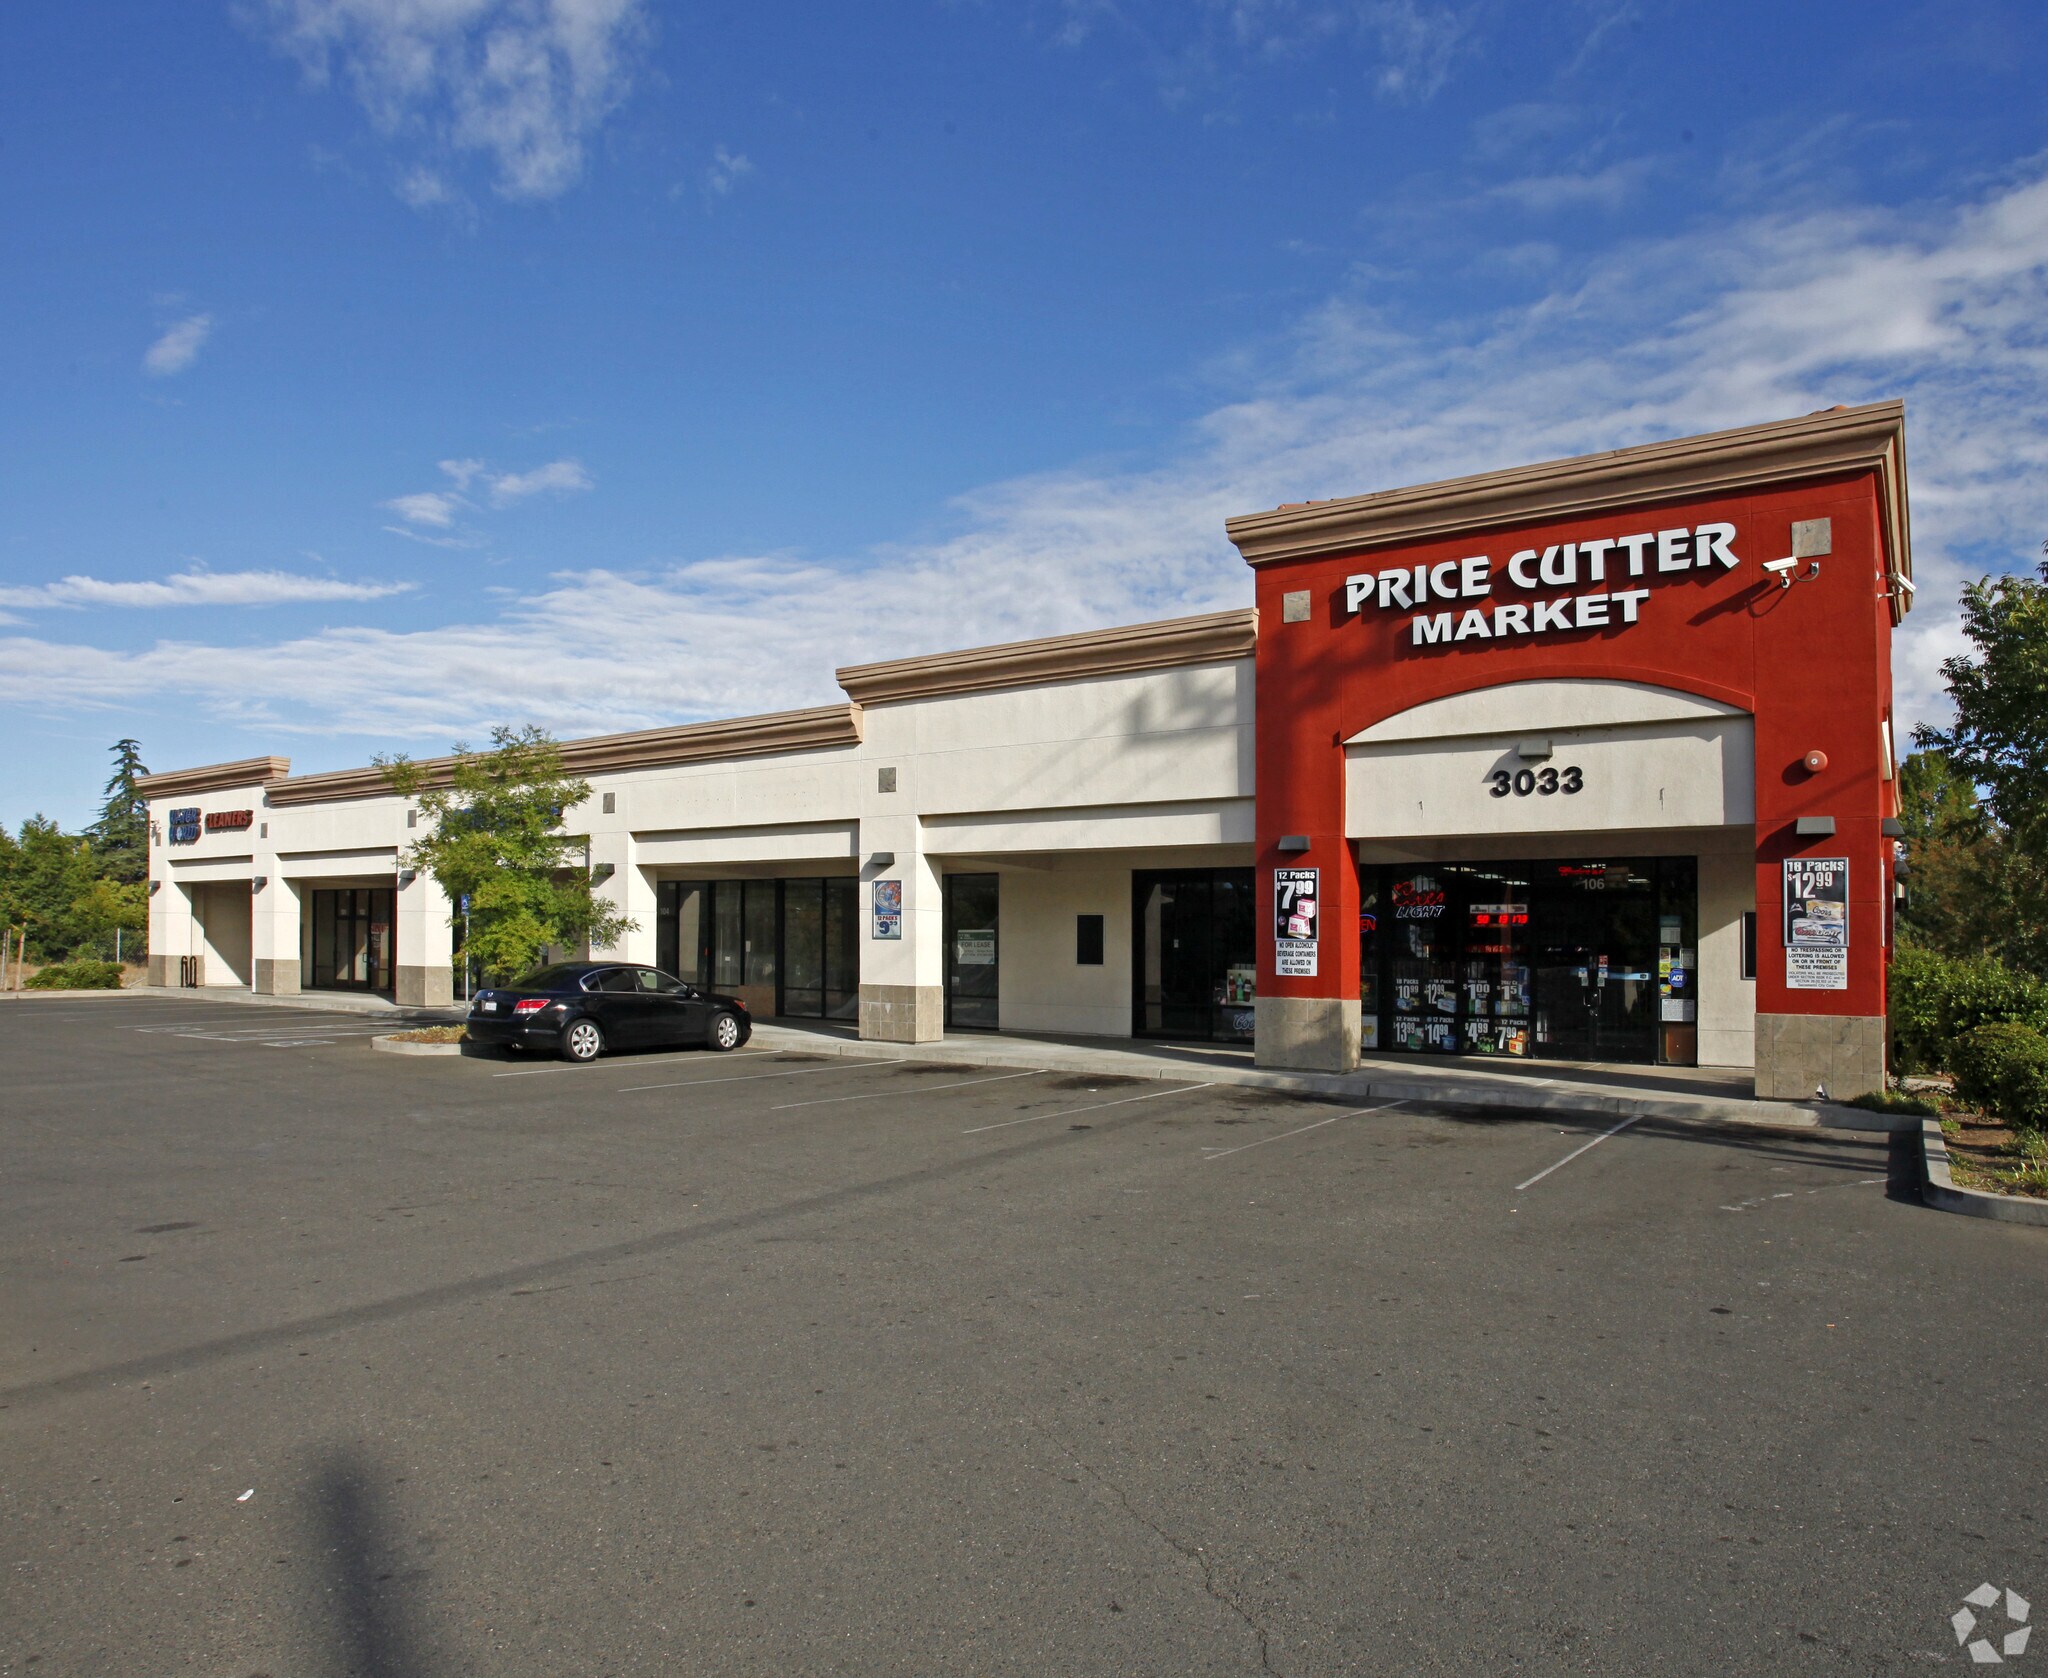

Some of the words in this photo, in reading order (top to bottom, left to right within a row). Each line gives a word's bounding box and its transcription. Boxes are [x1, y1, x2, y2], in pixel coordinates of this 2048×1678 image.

[1345, 555, 1492, 613] PRICE
[1508, 522, 1741, 589] CUTTER
[1412, 588, 1650, 646] MARKET
[1490, 765, 1584, 797] 3033
[205, 810, 253, 829] CLEANERS
[1787, 861, 1802, 871] 18
[1806, 861, 1845, 871] Packs
[1278, 871, 1288, 879] 12
[1290, 871, 1315, 879] Packs
[1584, 878, 1605, 890] 106
[1396, 905, 1446, 918] LIGHT
[1812, 906, 1832, 916] Coors
[1360, 919, 1376, 931] EN
[1233, 1013, 1255, 1030] Coo
